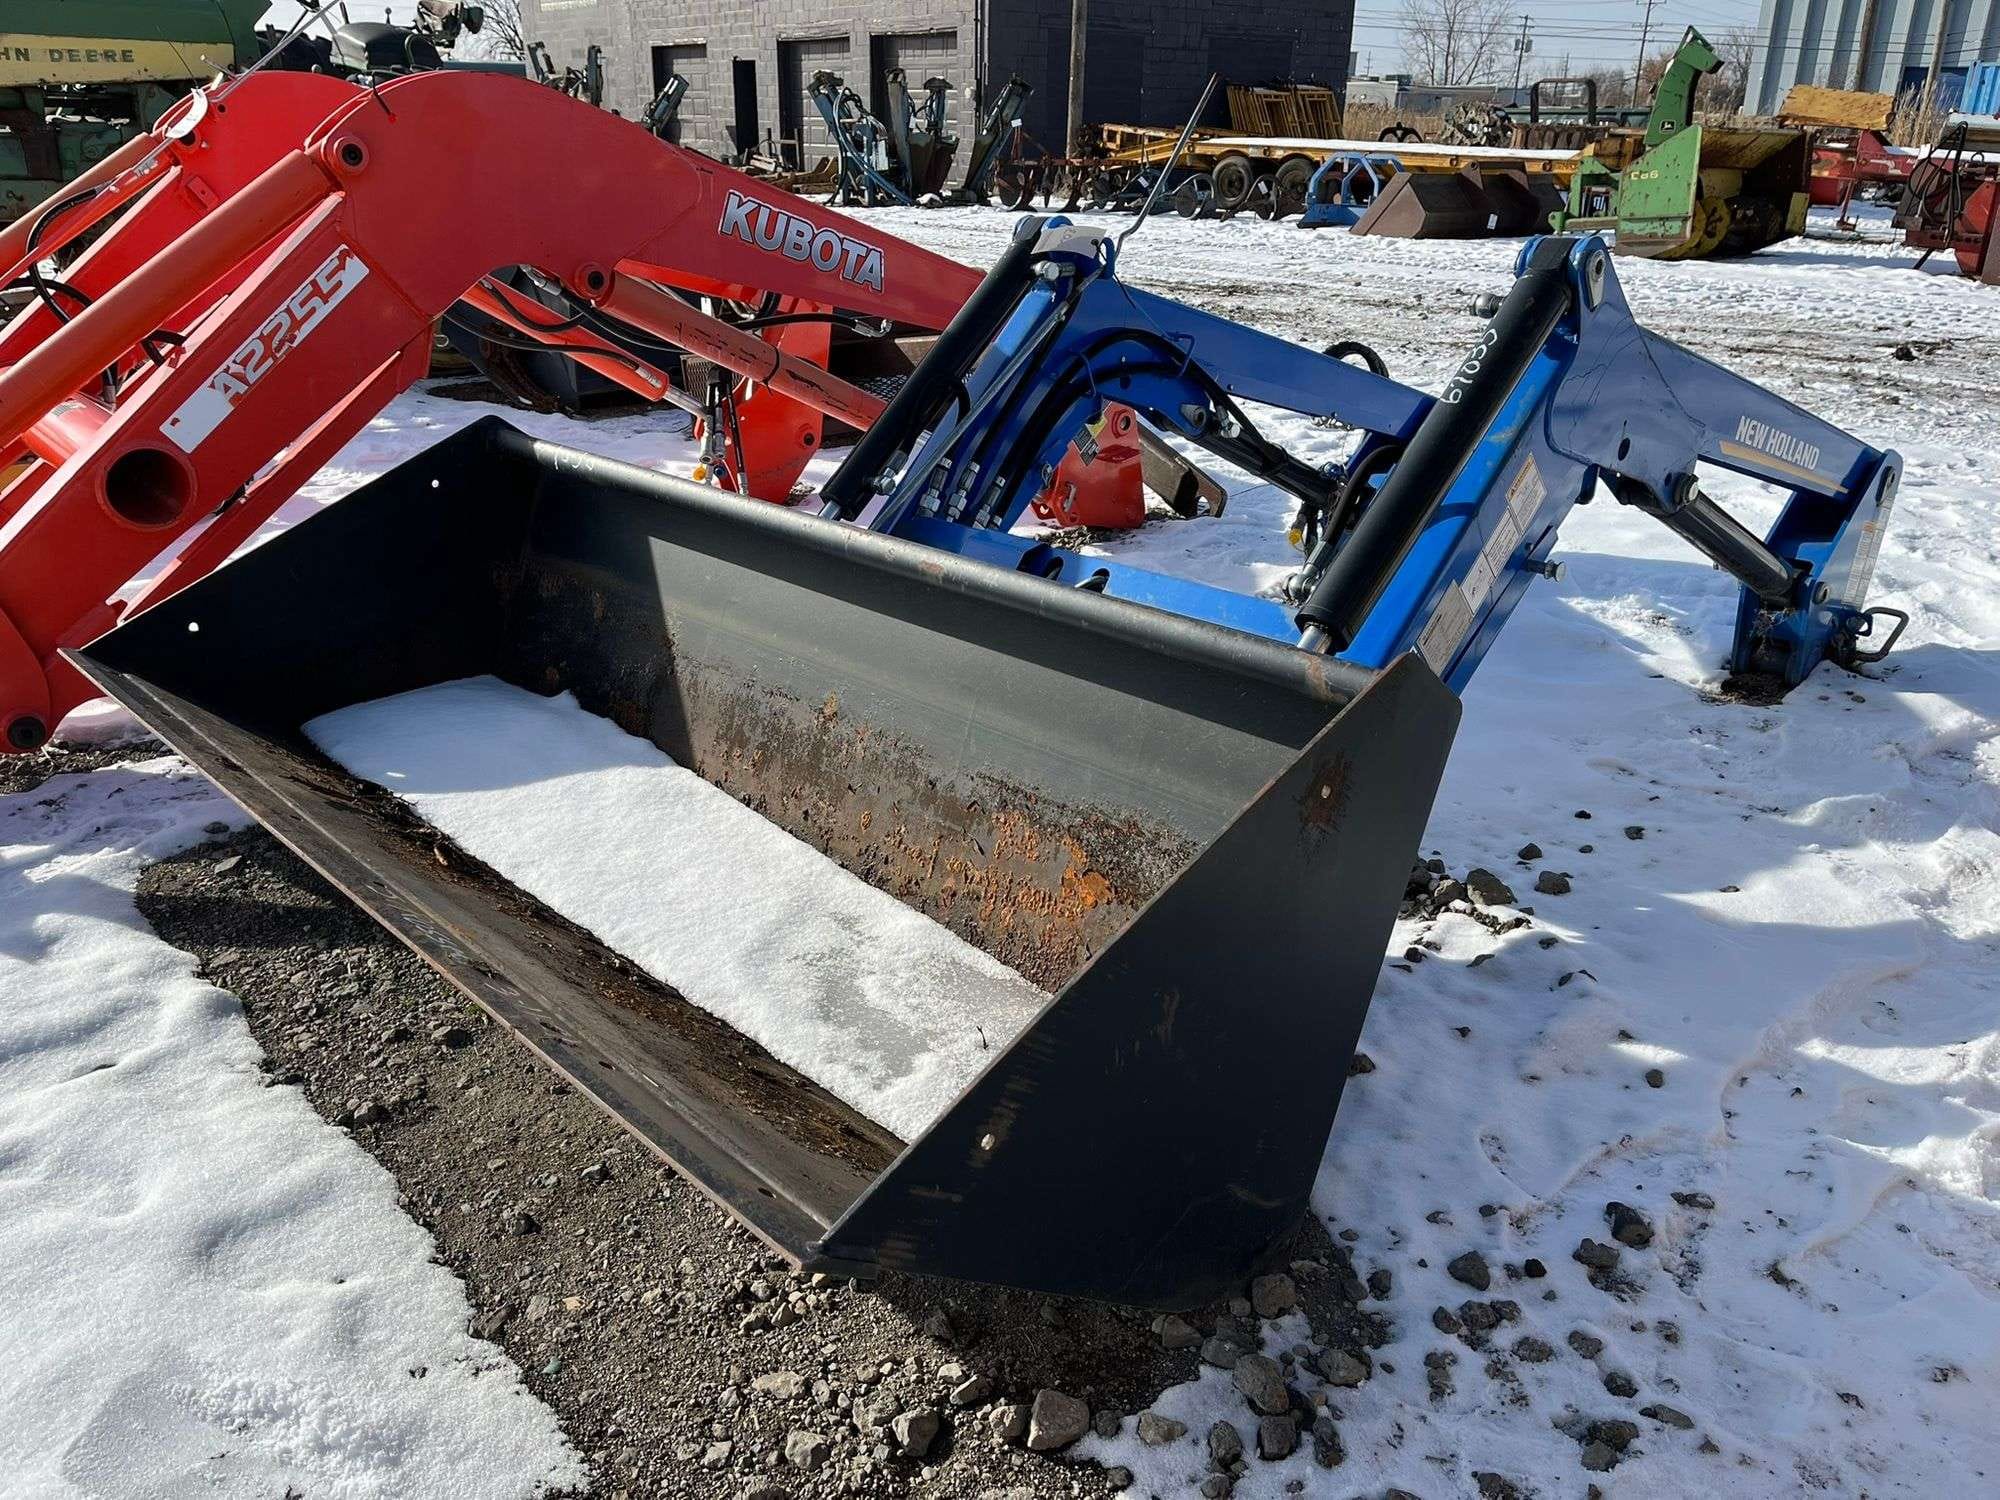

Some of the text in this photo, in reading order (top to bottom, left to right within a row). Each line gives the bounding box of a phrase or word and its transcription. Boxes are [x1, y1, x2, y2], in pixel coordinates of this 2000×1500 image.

[49, 48, 134, 63] DEERE
[719, 190, 884, 292] KUBOTA
[1735, 415, 1820, 470] NEW HOLLAND
